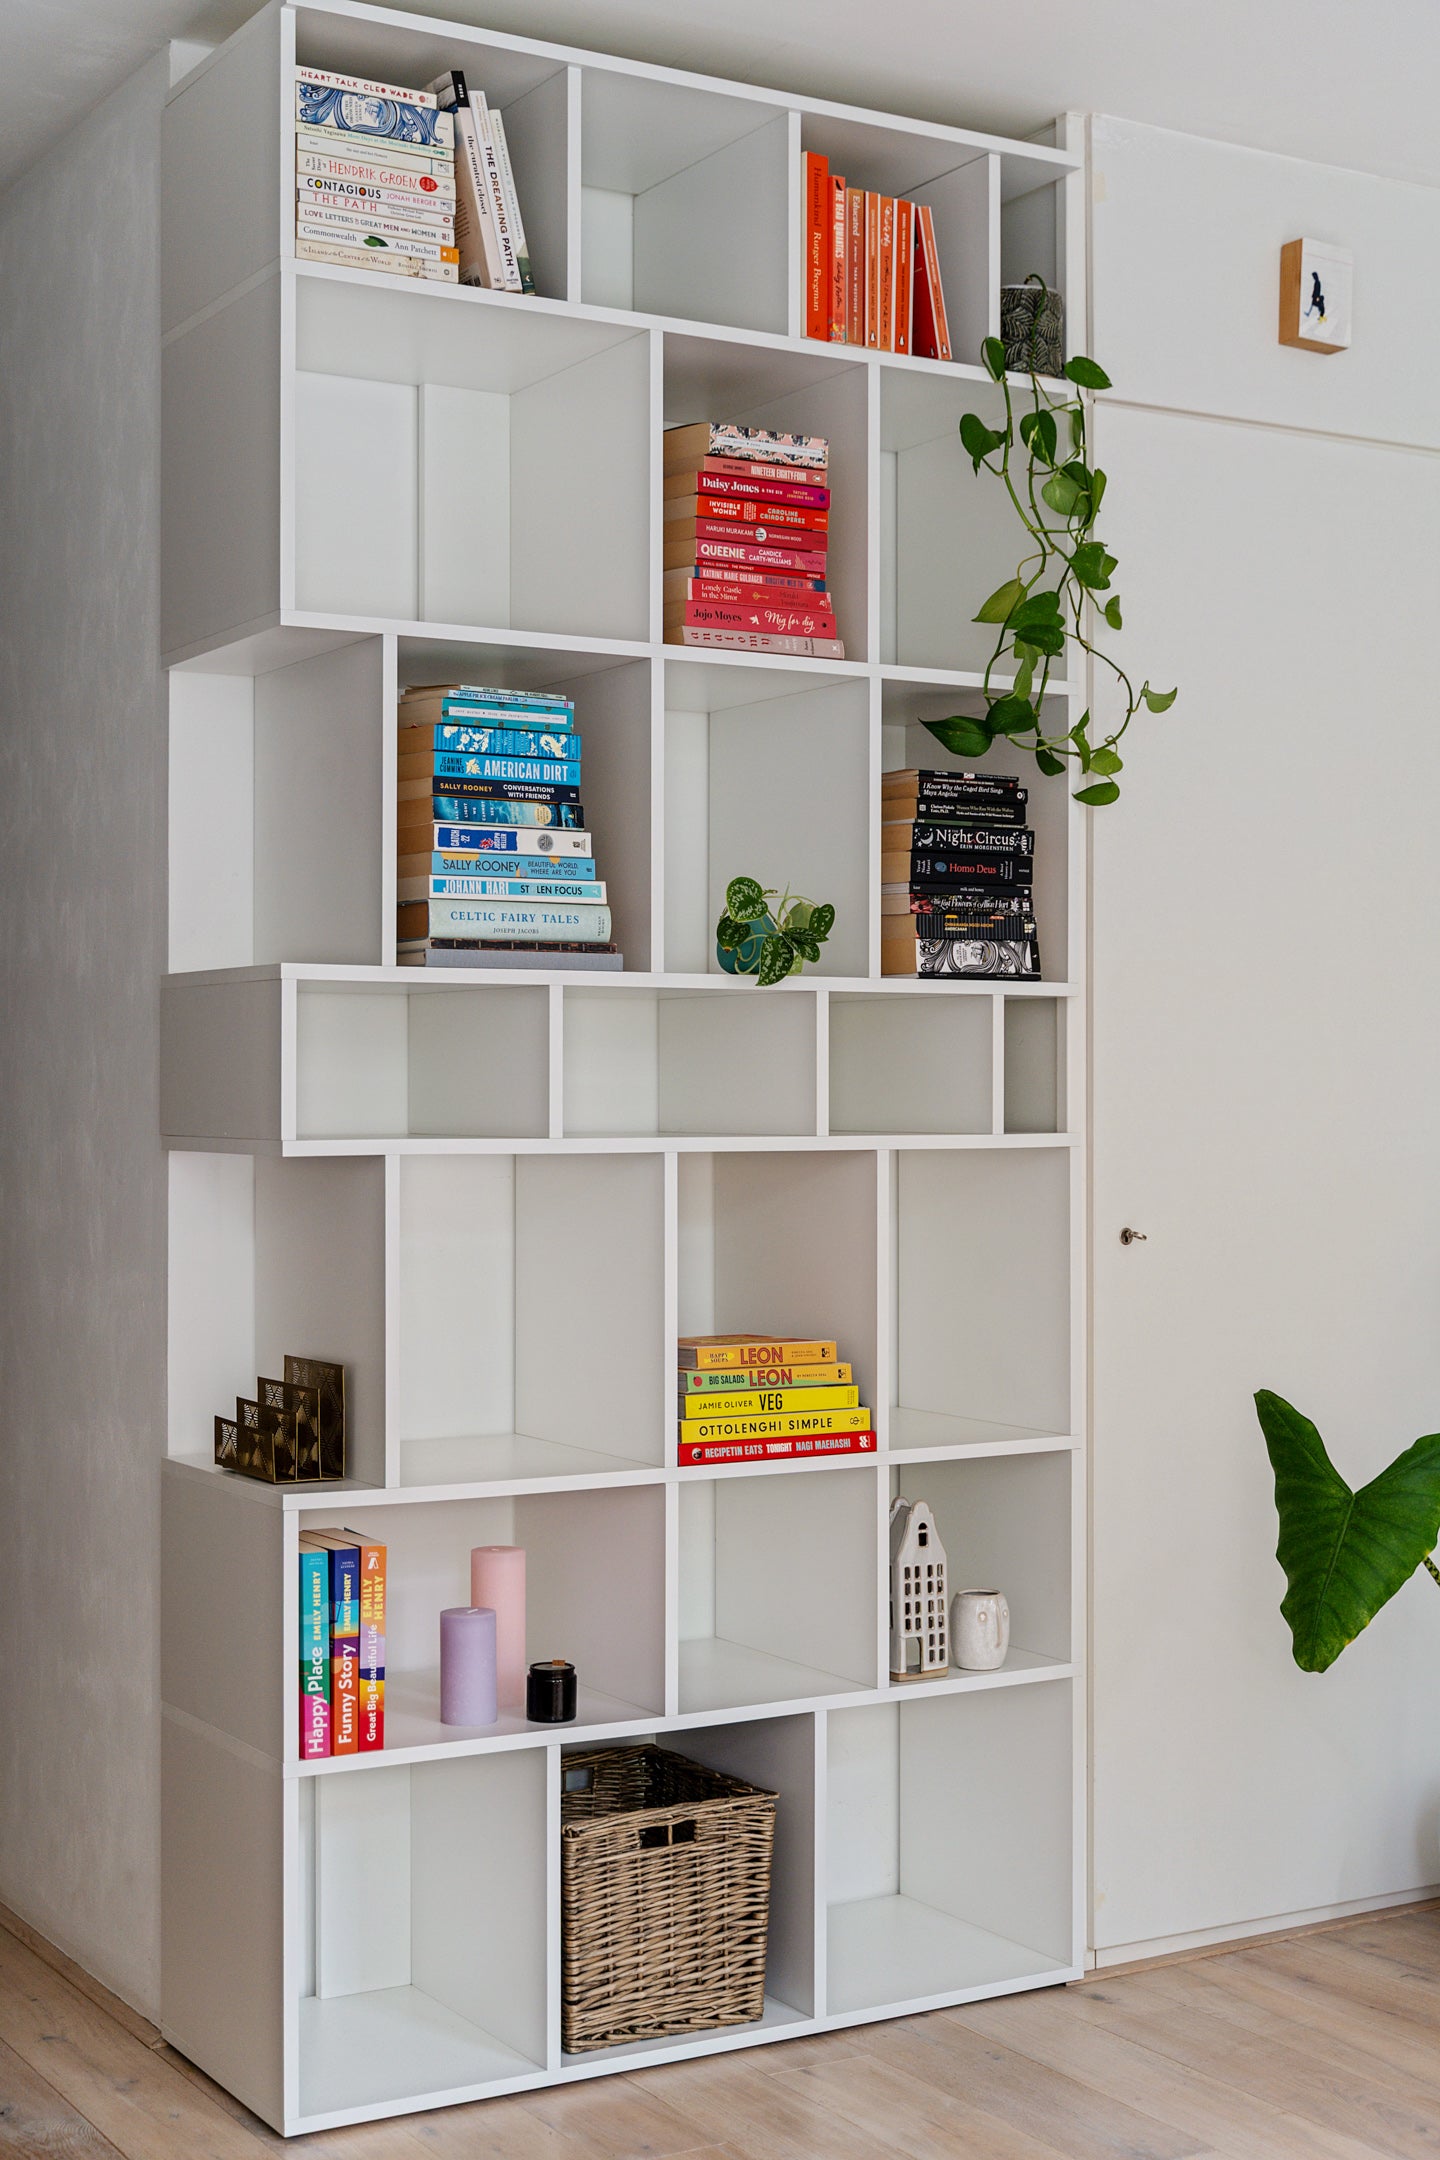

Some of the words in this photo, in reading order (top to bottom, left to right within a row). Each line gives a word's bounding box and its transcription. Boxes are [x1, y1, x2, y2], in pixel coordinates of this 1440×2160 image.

[301, 71, 331, 82] HEART
[336, 78, 358, 88] TALK
[364, 84, 386, 94] CLEO
[390, 90, 414, 100] WADE
[329, 160, 376, 180] HENDRIK
[307, 178, 381, 199] CONTAGIOUS
[386, 193, 411, 202] JONAH
[412, 196, 437, 207] BERGER
[470, 152, 483, 187] curated
[478, 188, 487, 215] closet
[312, 192, 338, 206] THE
[344, 195, 377, 212] PATH
[485, 146, 495, 168] THE
[490, 172, 508, 233] DREAMING
[502, 237, 514, 267] PATH
[813, 167, 822, 227] Humankind
[304, 209, 323, 218] LOVE
[325, 212, 354, 224] LETTERS
[360, 219, 383, 229] GREAT
[383, 223, 399, 232] MEN
[411, 228, 437, 239] WOMEN
[303, 225, 357, 242] Commonwealth
[394, 242, 409, 251] Ann
[410, 244, 437, 256] Patchett
[813, 231, 822, 266] Rutger
[813, 267, 822, 312] Bregman
[702, 477, 730, 492] Daisy
[731, 481, 760, 493] Jones
[709, 500, 741, 510] INVISIBLE
[712, 507, 737, 516] WOMEN
[767, 508, 798, 517] CAROLINE
[760, 513, 784, 522] CRIADO
[706, 525, 725, 534] HARUKI
[726, 528, 754, 537] MURAKAMI
[701, 543, 745, 559] QUEENIE
[748, 555, 792, 566] CARTY-WILLIAMS
[758, 549, 782, 558] CANDICE
[703, 569, 722, 579] KATRINE
[724, 570, 739, 581] MARIE
[701, 583, 721, 593] Lonely
[723, 586, 742, 594] Castle
[694, 609, 713, 621] Jojo
[715, 610, 742, 623] Moyes
[764, 610, 787, 631] Mig
[788, 614, 800, 630] for
[802, 615, 815, 634] dig
[441, 756, 463, 765] JEANINE
[440, 764, 465, 774] CUMMINS
[484, 760, 542, 779] AMERICAN
[544, 764, 568, 781] DIRT
[463, 784, 493, 792] ROONEY
[503, 784, 555, 793] CONVERSATIONS
[525, 792, 551, 800] FRIENDS
[451, 830, 460, 846] CATCH
[936, 829, 972, 846] Night
[975, 832, 1015, 845] Circus
[443, 860, 472, 871] SALLY
[475, 860, 520, 872] ROONEY
[527, 861, 556, 869] BEAUTIFUL
[949, 863, 975, 873] Homo
[976, 864, 997, 874] Deus
[442, 879, 482, 894] JOHANN
[486, 880, 508, 895] HARI
[555, 886, 582, 895] FOCUS
[450, 911, 496, 921] CELTIC
[501, 912, 537, 923] FAIRY
[542, 914, 580, 924] TALES
[740, 1346, 784, 1365] LEON
[709, 1376, 719, 1385] BIG
[720, 1374, 745, 1385] SALADS
[748, 1368, 793, 1387] LEON
[698, 1402, 722, 1410] JAMIE
[724, 1400, 753, 1408] OLIVER
[759, 1393, 783, 1411] VEG
[699, 1420, 782, 1436] OTTOLENGHI
[789, 1417, 832, 1430] SIMPLE
[705, 1445, 744, 1458] RECIPETIN
[745, 1444, 763, 1455] EATS
[766, 1442, 792, 1453] TONIGHT
[796, 1441, 813, 1451] NAGI
[815, 1438, 851, 1450] MAEHASHI
[312, 1571, 321, 1607] HENRY
[362, 1579, 372, 1618] EMILY
[374, 1576, 384, 1620] HENRY
[313, 1610, 321, 1640] EMILY
[368, 1624, 378, 1644] Life
[308, 1646, 323, 1692] Place
[338, 1644, 356, 1689] Story
[368, 1646, 377, 1692] Beautiful
[367, 1694, 379, 1710] Big
[308, 1695, 328, 1753] Happy
[338, 1692, 356, 1744] Funny
[367, 1711, 376, 1742] Great
